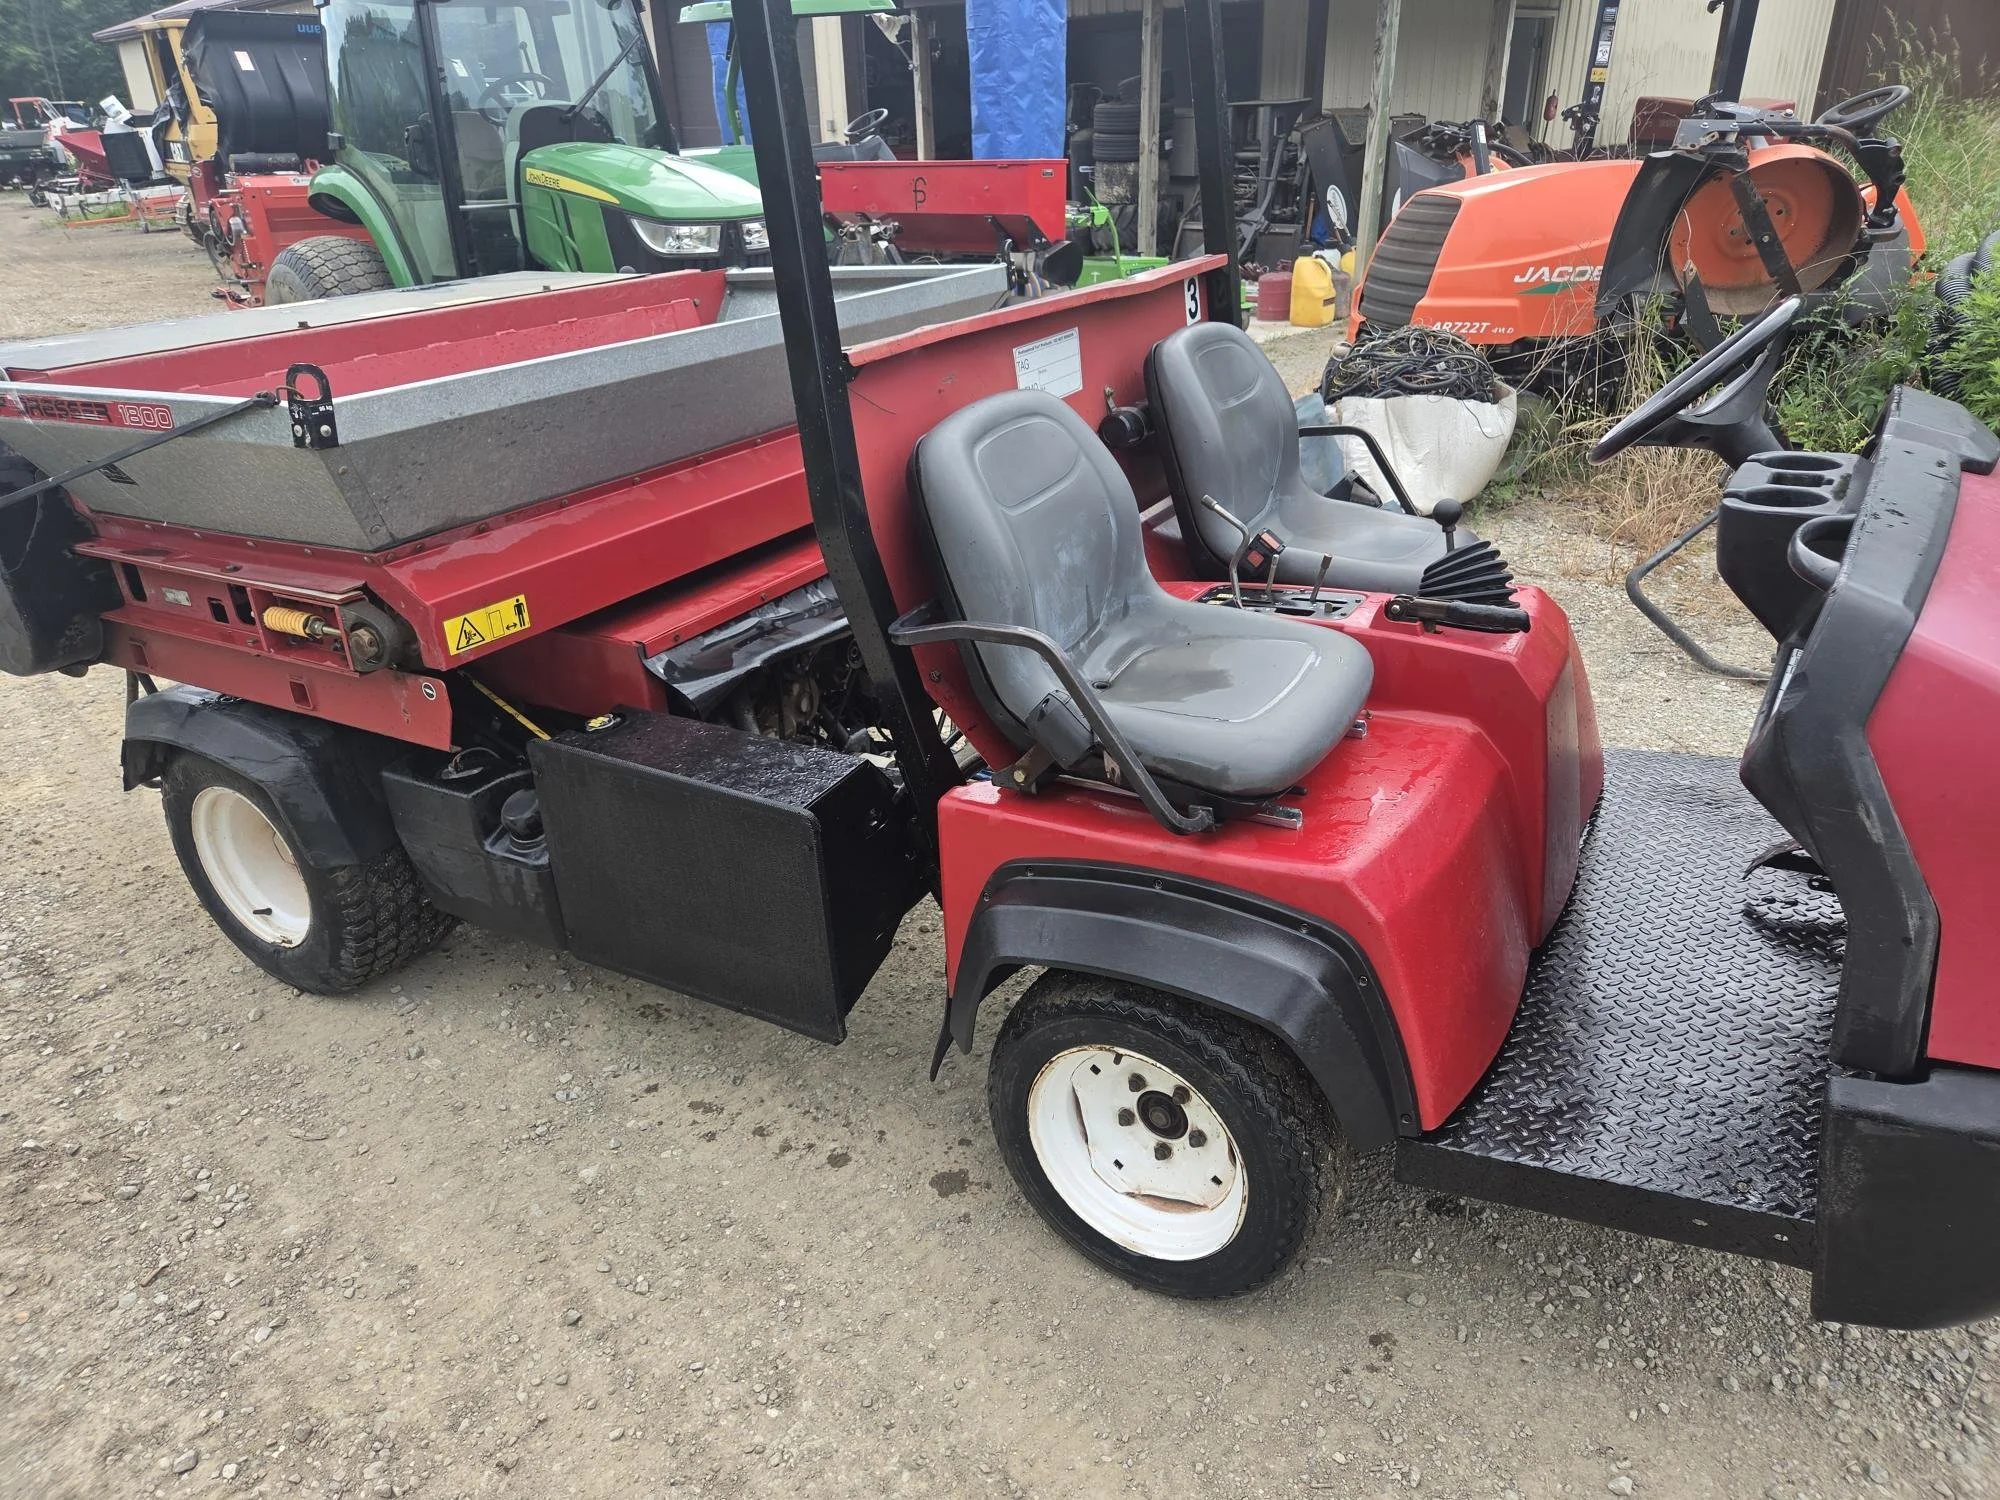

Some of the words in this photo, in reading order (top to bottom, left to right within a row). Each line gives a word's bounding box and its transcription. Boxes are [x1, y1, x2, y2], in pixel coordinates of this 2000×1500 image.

[1187, 277, 1198, 319] 3
[1432, 321, 1491, 334] AR722T
[1016, 358, 1030, 372] TAG
[118, 404, 173, 429] 1800
